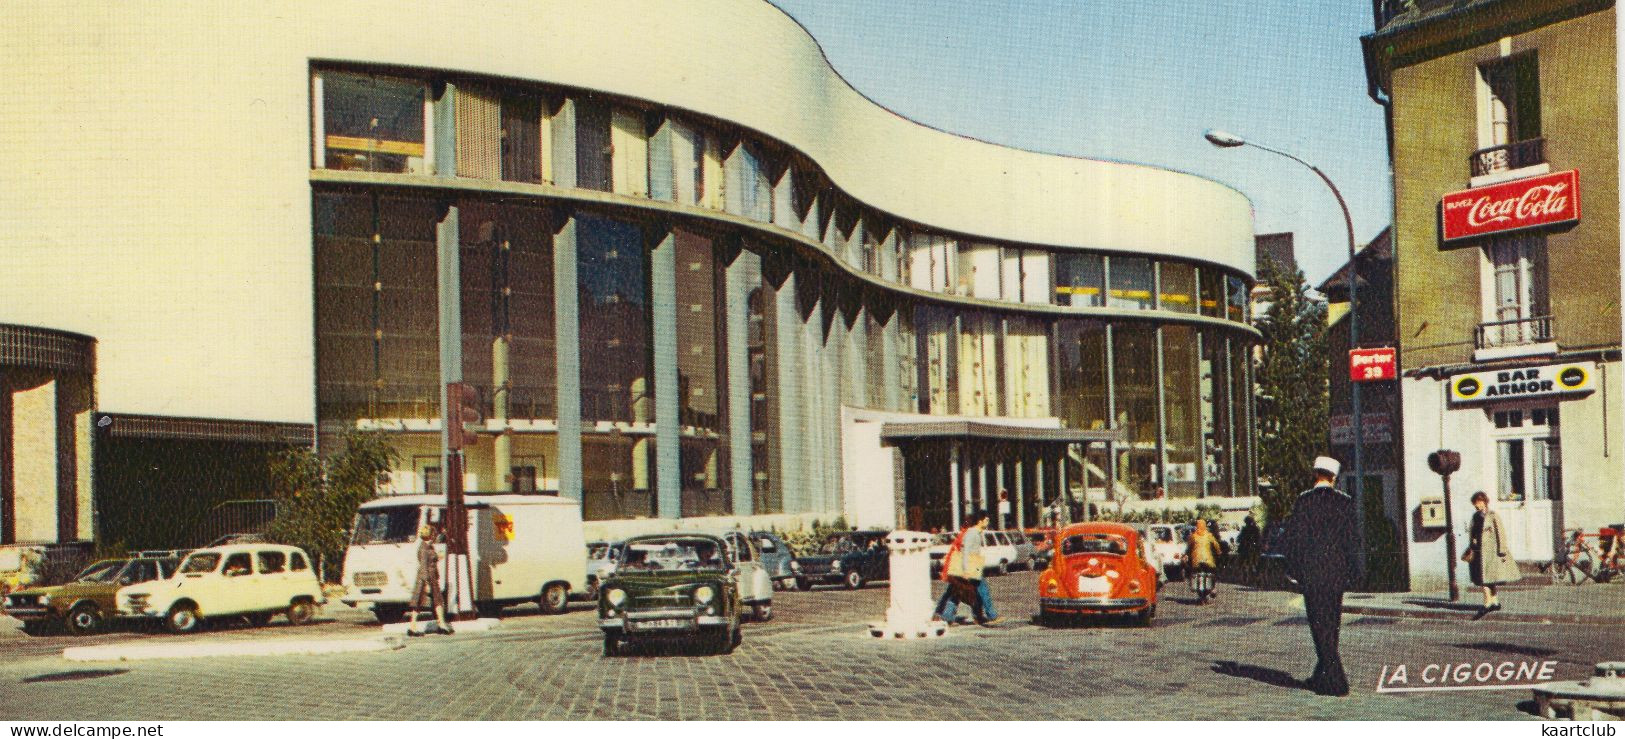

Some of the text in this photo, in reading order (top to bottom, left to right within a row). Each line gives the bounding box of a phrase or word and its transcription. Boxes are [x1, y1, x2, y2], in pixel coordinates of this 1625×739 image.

[1468, 182, 1568, 227] Coca-Cola
[1497, 369, 1540, 383] BAR
[1486, 380, 1554, 397] ARMOR
